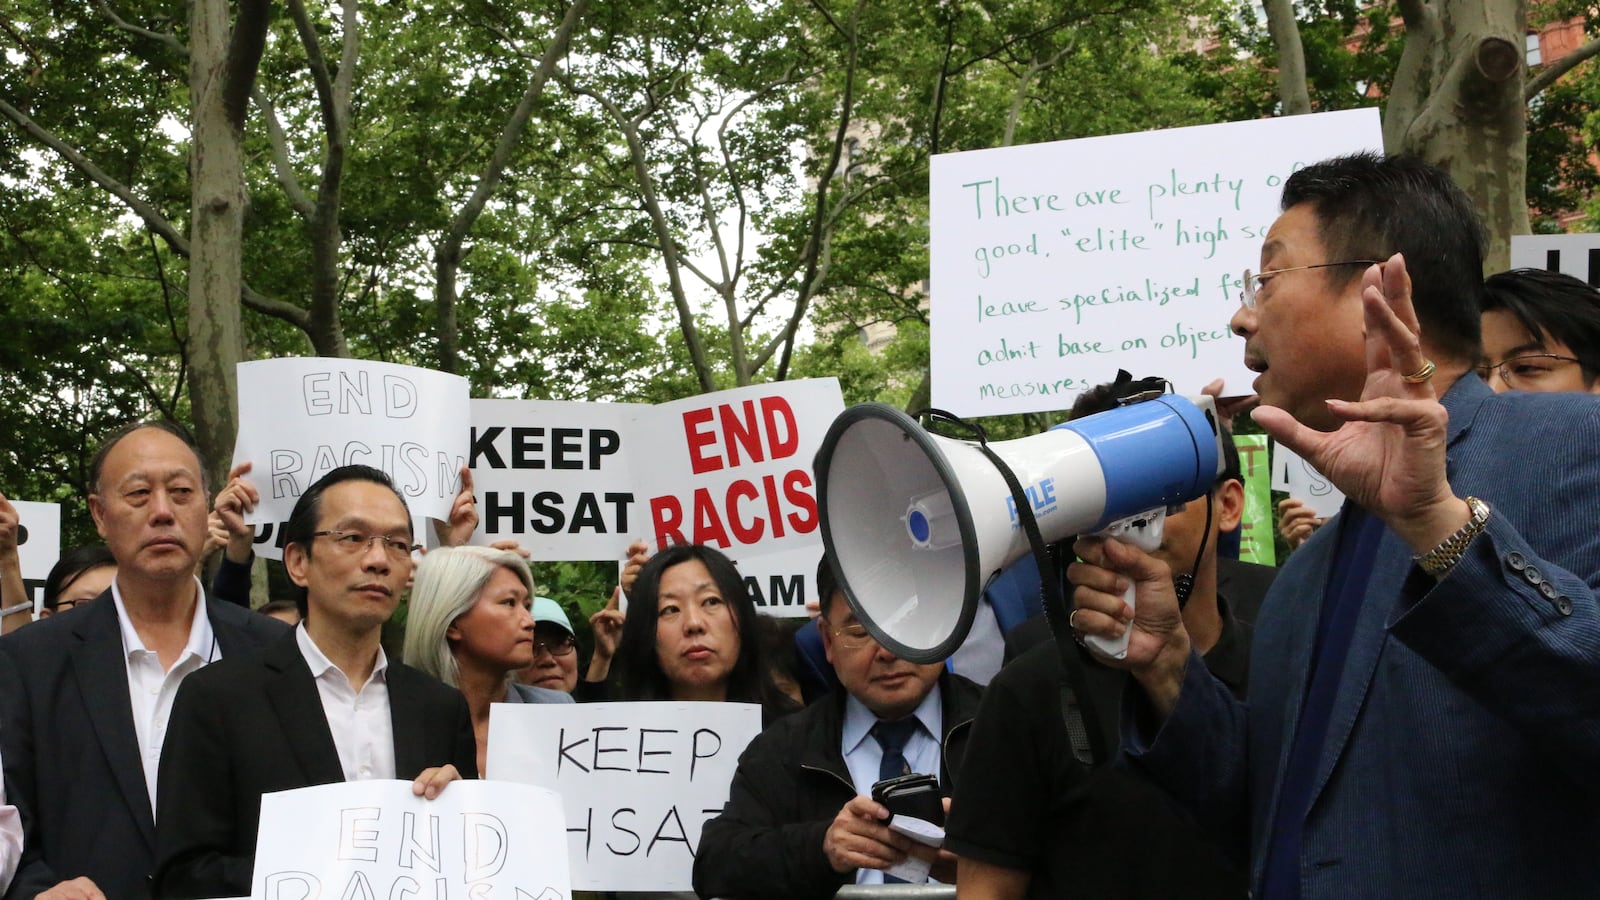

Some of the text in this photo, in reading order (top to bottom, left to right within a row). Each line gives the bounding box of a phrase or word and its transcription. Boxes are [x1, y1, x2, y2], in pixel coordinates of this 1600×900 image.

[962, 176, 1066, 220] There
[1075, 188, 1131, 208] are
[1148, 168, 1243, 220] plenty
[1060, 223, 1165, 253] "elite"
[1176, 217, 1229, 259] high
[978, 295, 1049, 323] leave
[1059, 278, 1200, 325] specialized
[977, 322, 1233, 366] admit base on object
[303, 370, 418, 418] END
[979, 376, 1090, 401] measures
[468, 426, 621, 470] KEEP
[682, 395, 799, 475] END
[473, 491, 635, 534] HSAT
[649, 468, 820, 551] RACIS
[742, 574, 805, 607] AM
[557, 727, 722, 782] KEEP
[337, 807, 509, 884] END
[566, 805, 724, 864] HSA
